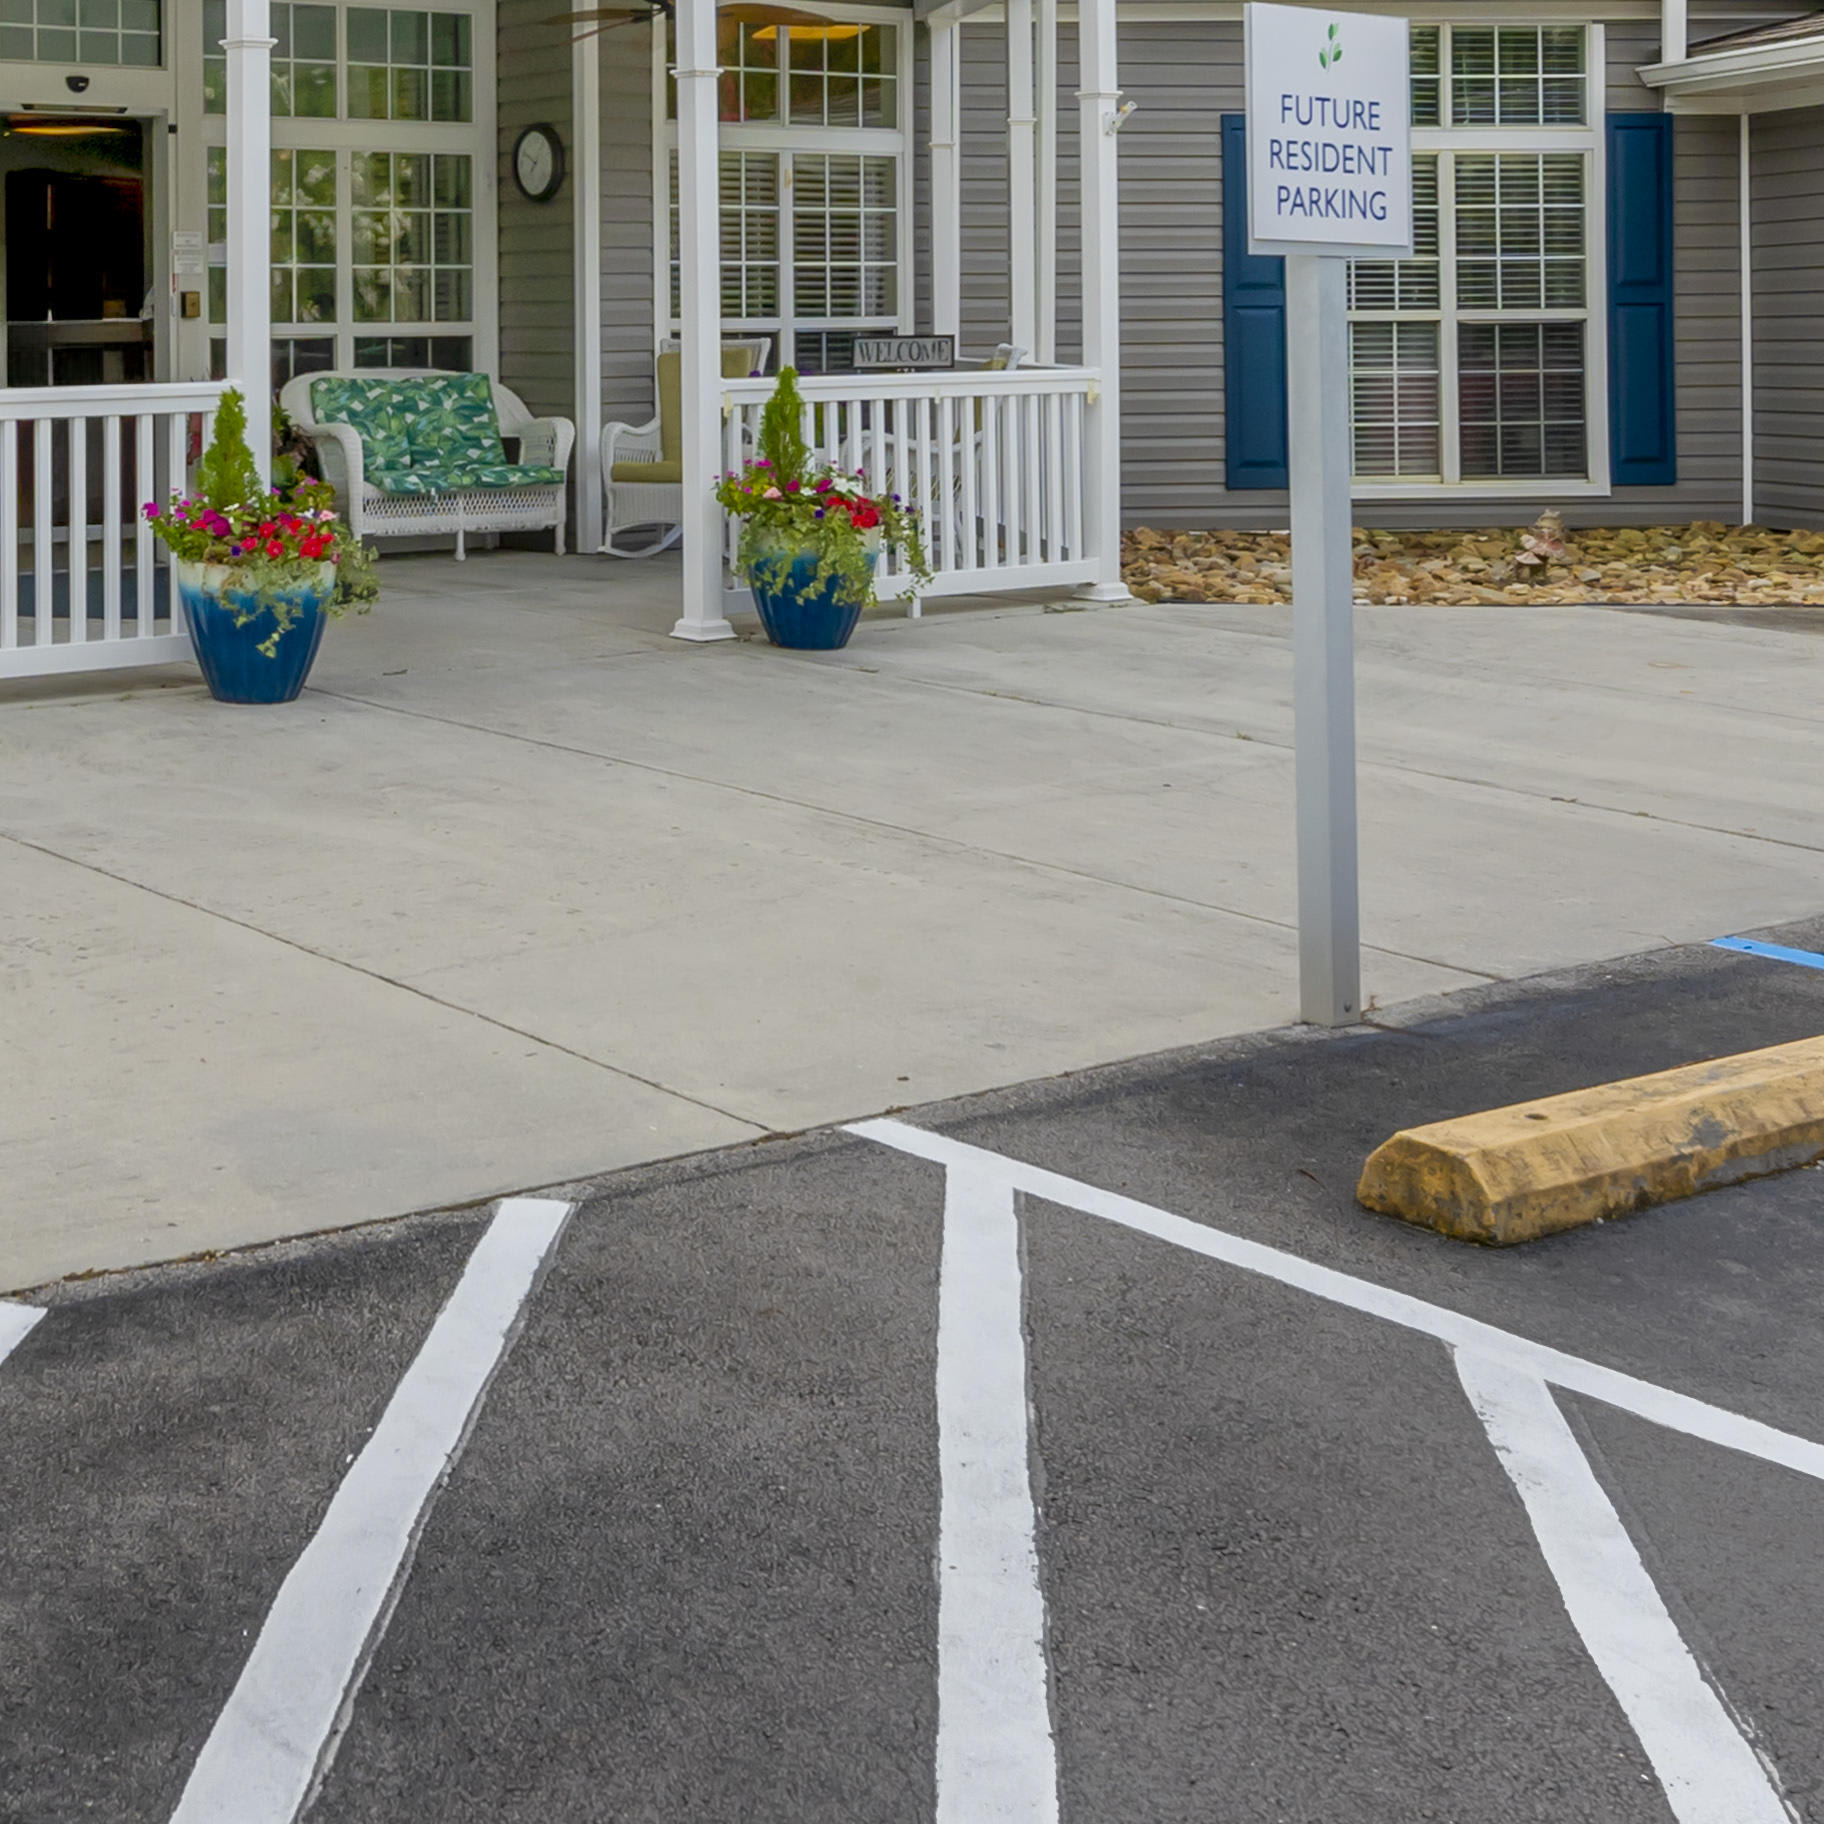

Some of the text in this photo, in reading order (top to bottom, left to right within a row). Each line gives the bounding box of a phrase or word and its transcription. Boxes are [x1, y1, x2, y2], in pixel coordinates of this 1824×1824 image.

[1281, 94, 1380, 131] FUTURE
[1269, 139, 1393, 176] RESIDENT
[1277, 185, 1387, 221] PARKING
[858, 340, 949, 363] WELCOME
